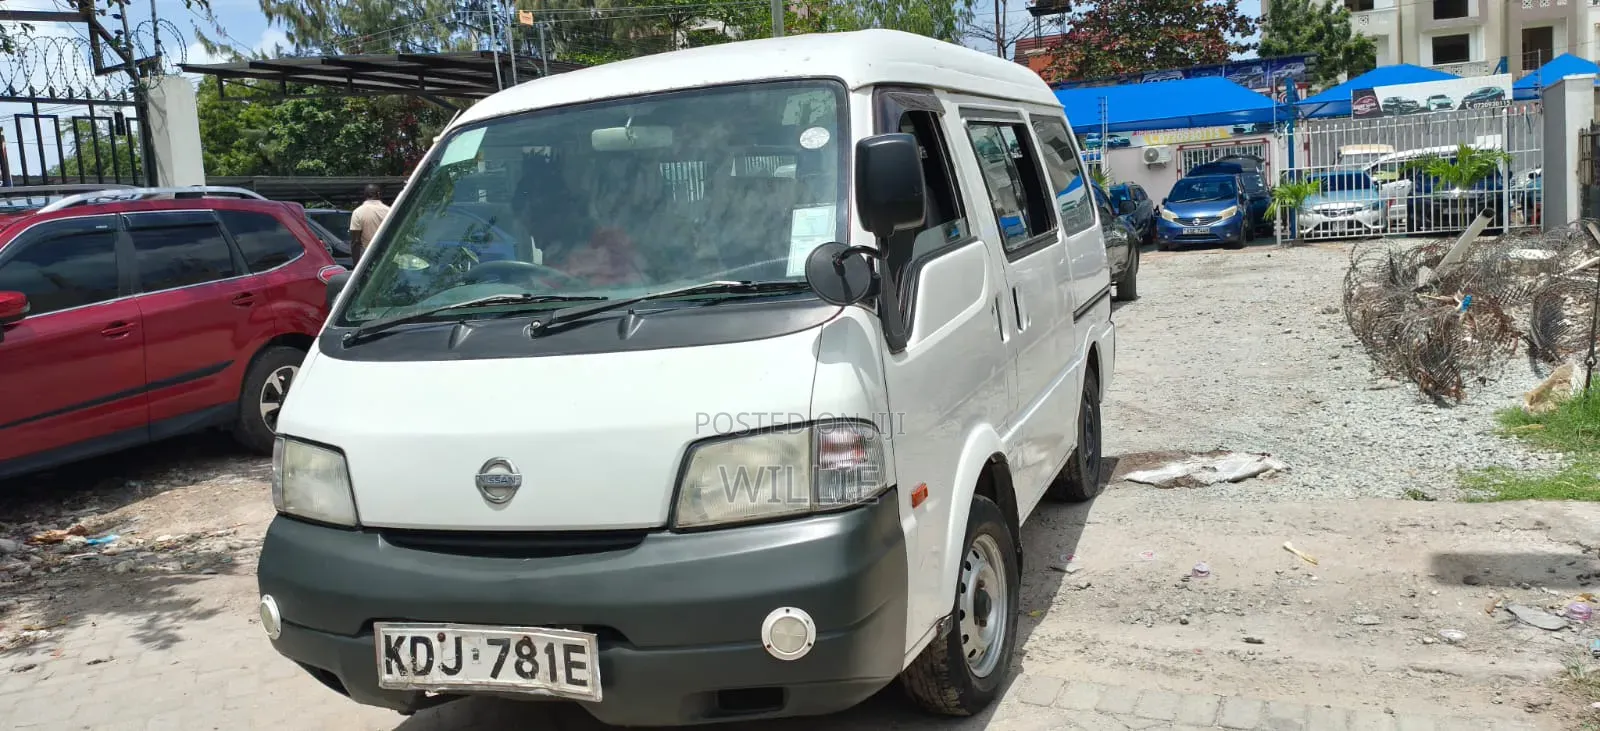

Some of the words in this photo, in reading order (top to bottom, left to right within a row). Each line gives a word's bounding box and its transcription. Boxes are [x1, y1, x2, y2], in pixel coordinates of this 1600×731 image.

[479, 475, 516, 484] NISSAN
[384, 634, 463, 677] KDJ
[487, 636, 588, 687] 781E
